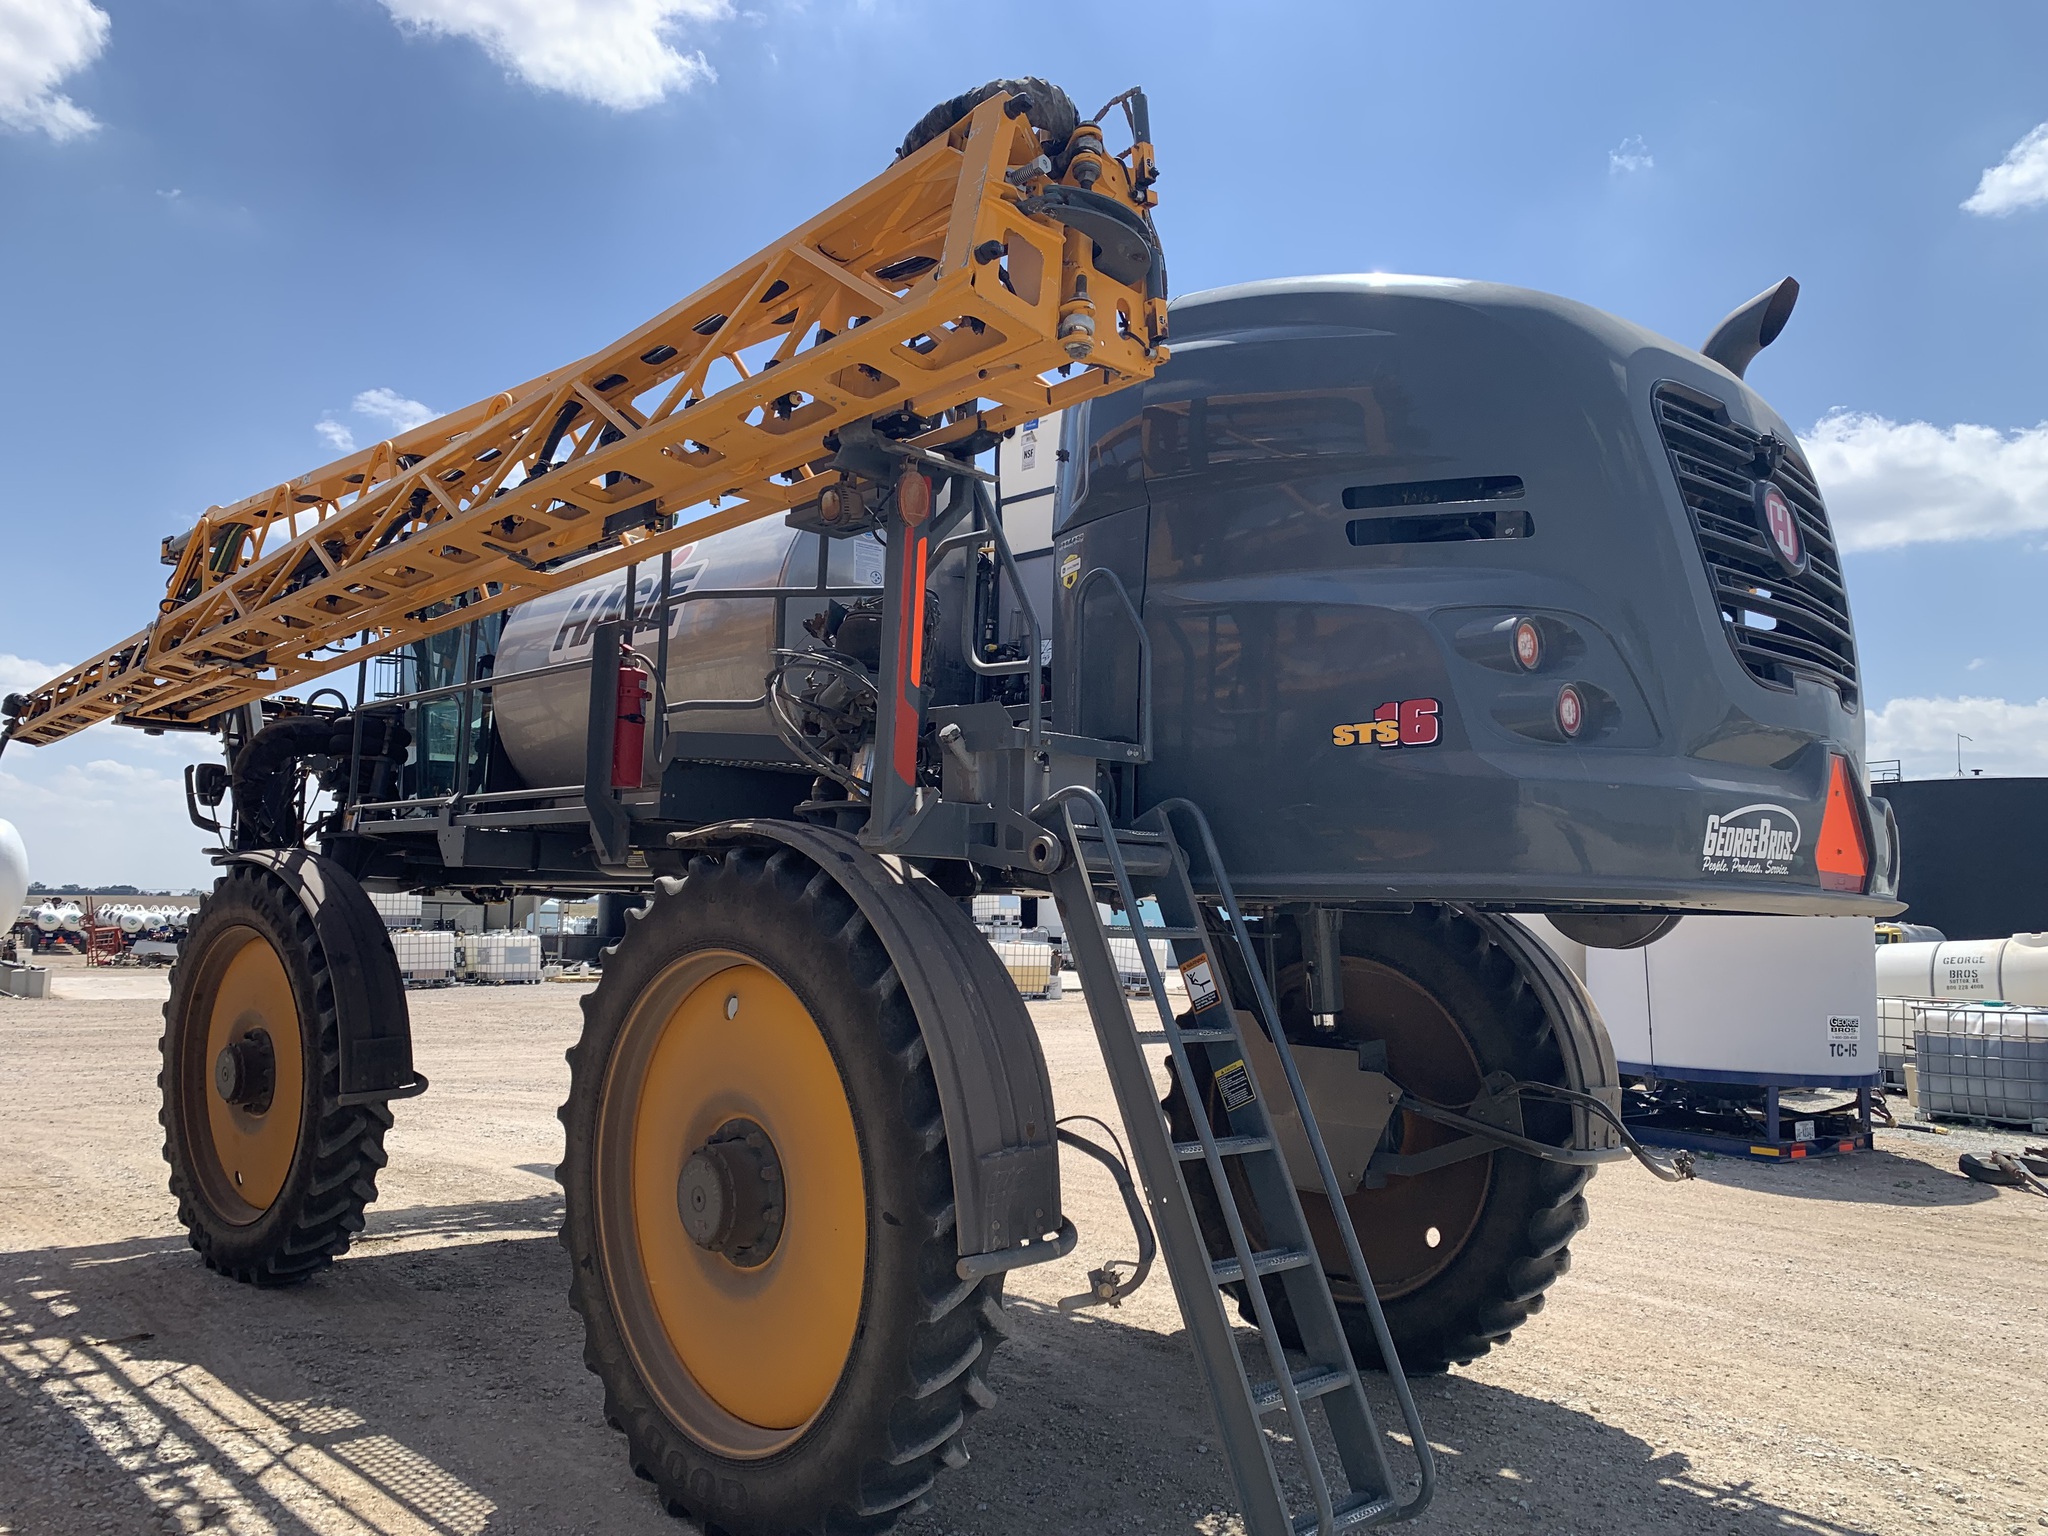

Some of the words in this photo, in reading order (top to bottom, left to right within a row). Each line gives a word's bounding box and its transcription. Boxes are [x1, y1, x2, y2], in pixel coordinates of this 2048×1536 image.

[1023, 448, 1034, 460] NSF
[1702, 856, 1729, 875] People.
[1731, 858, 1763, 874] Products.
[1764, 860, 1789, 875] Service.
[1942, 955, 1986, 965] GEORGE
[1949, 969, 1978, 979] BROS
[1829, 1043, 1858, 1058] TC-15
